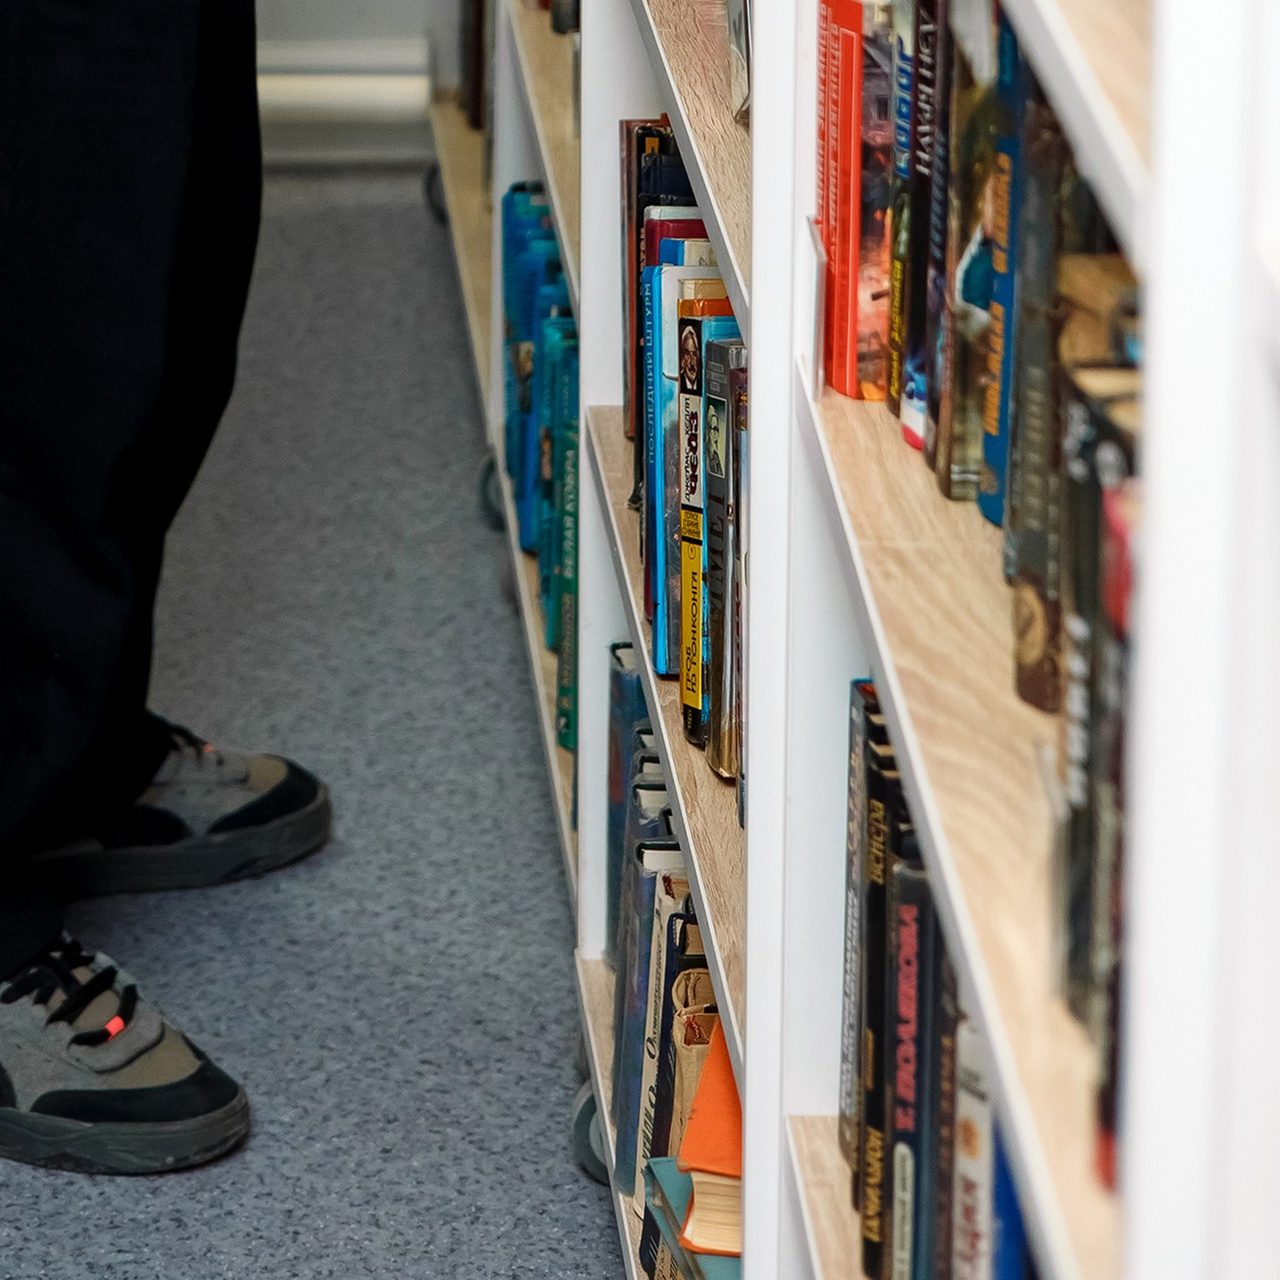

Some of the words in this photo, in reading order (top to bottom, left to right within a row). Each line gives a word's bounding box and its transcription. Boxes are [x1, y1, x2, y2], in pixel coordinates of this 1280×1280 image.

[643, 282, 653, 346] ШТУРМ
[646, 351, 655, 463] ПОСЛЕДНИЙ
[690, 570, 698, 666] ГОНКОНГА
